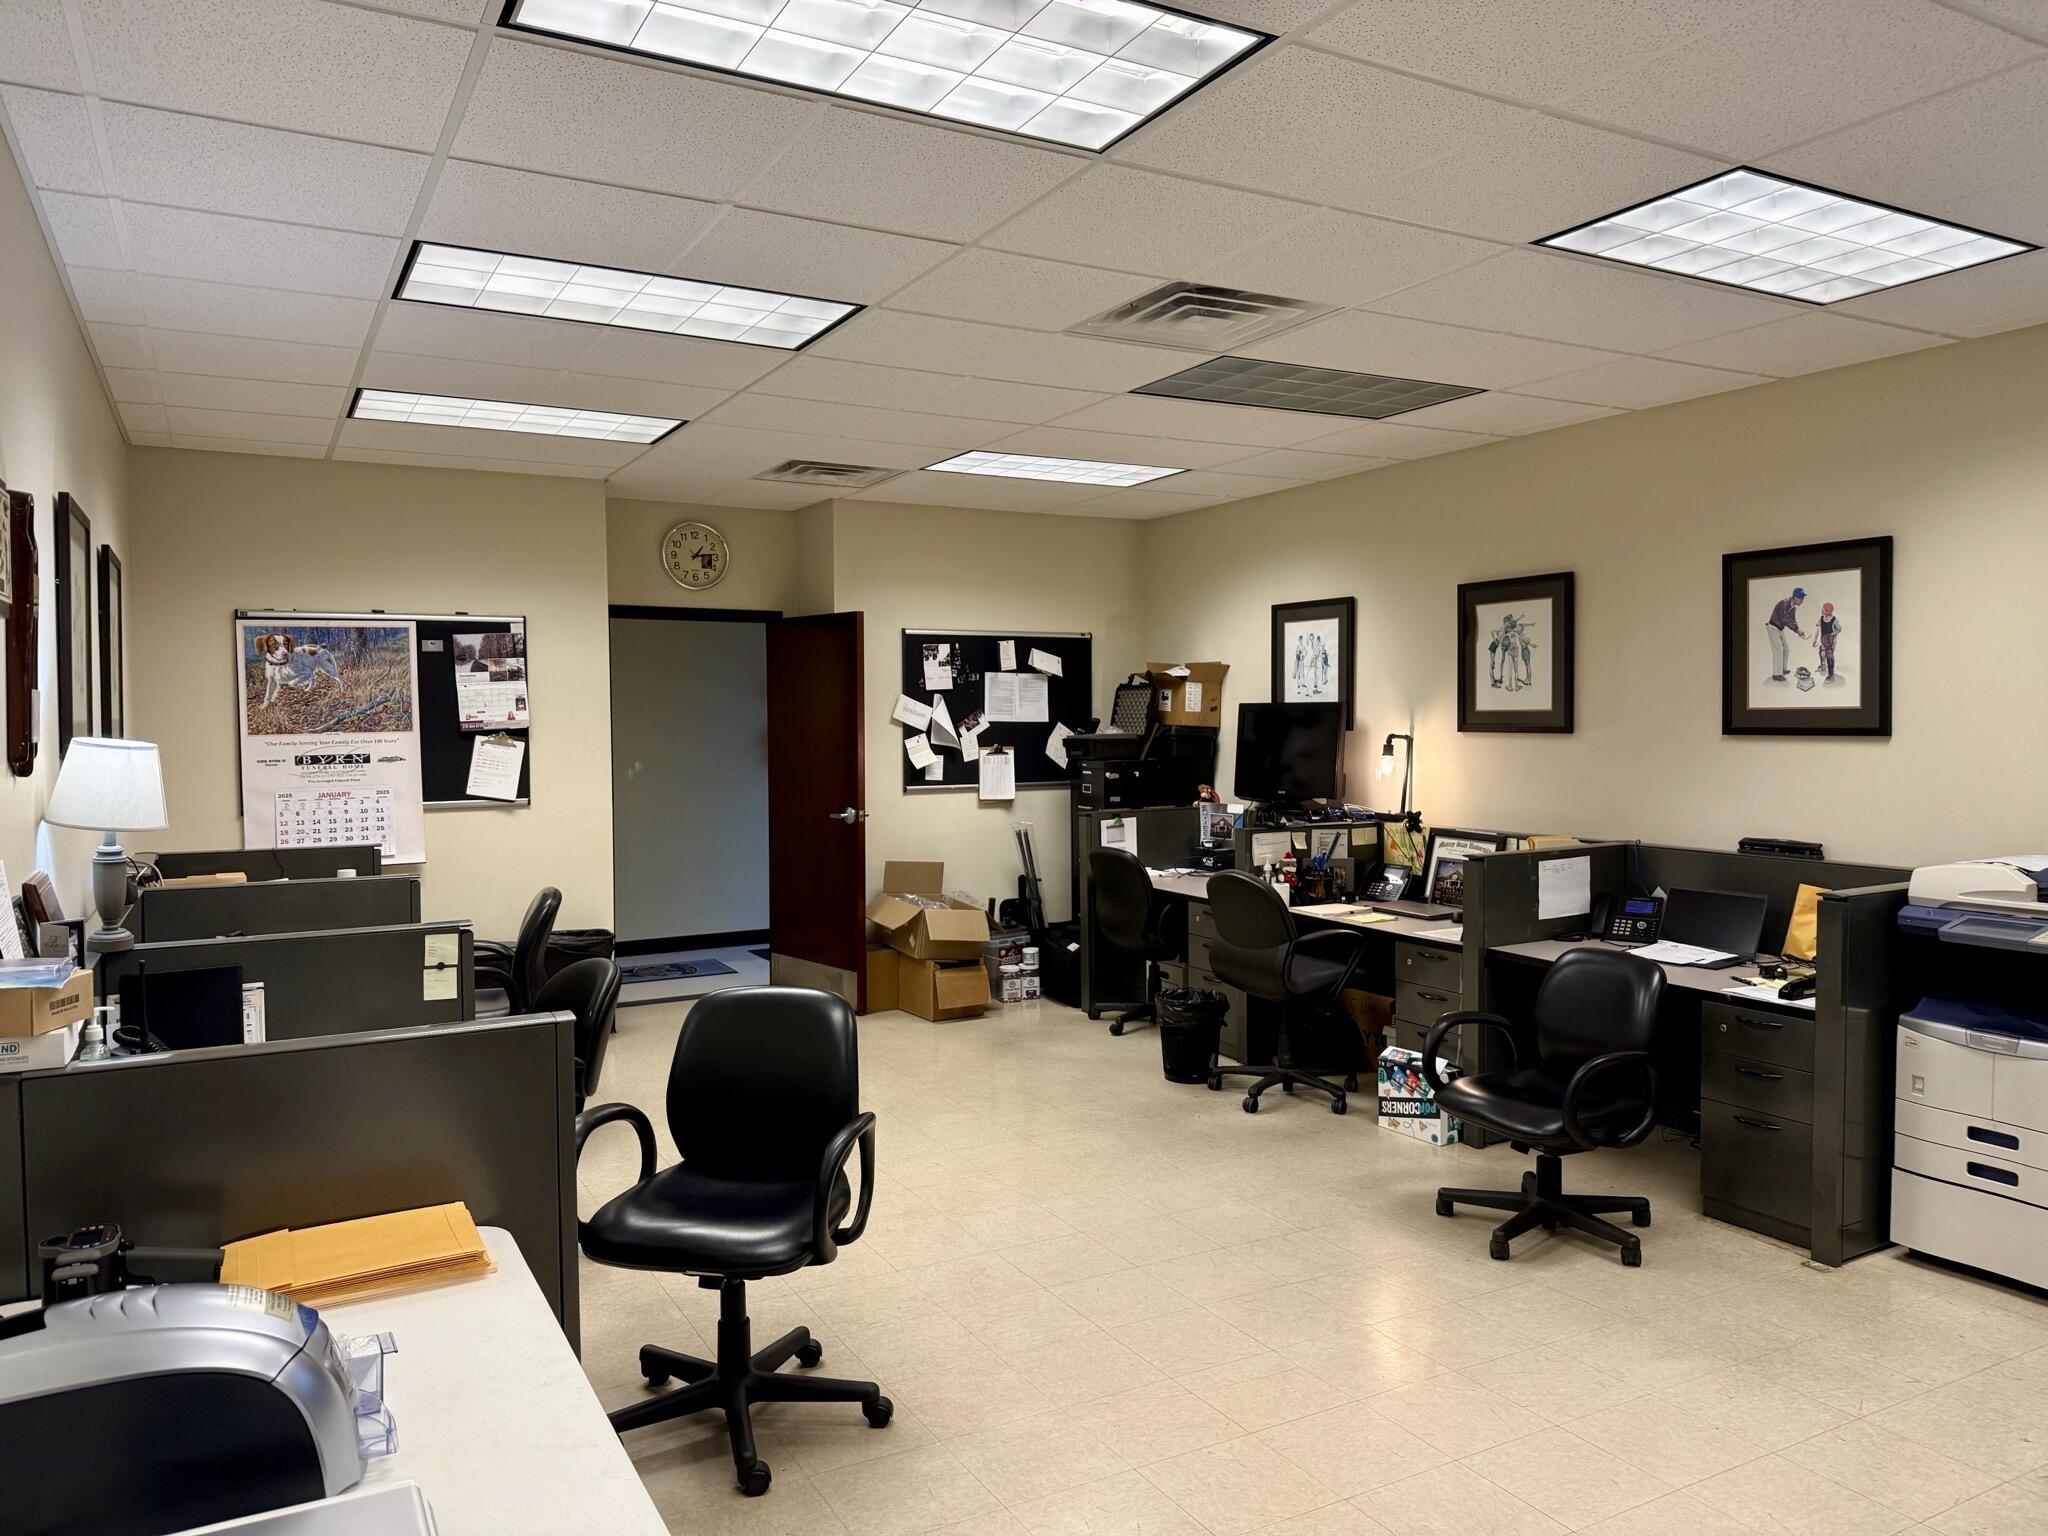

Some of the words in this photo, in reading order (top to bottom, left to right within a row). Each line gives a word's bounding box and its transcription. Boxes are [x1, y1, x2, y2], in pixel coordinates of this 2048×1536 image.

[690, 531, 699, 539] 12
[672, 540, 681, 548] 10
[674, 562, 680, 570] 8
[693, 573, 699, 581] 6
[302, 754, 364, 765] BYRN
[1382, 1100, 1436, 1115] POPCORNERS
